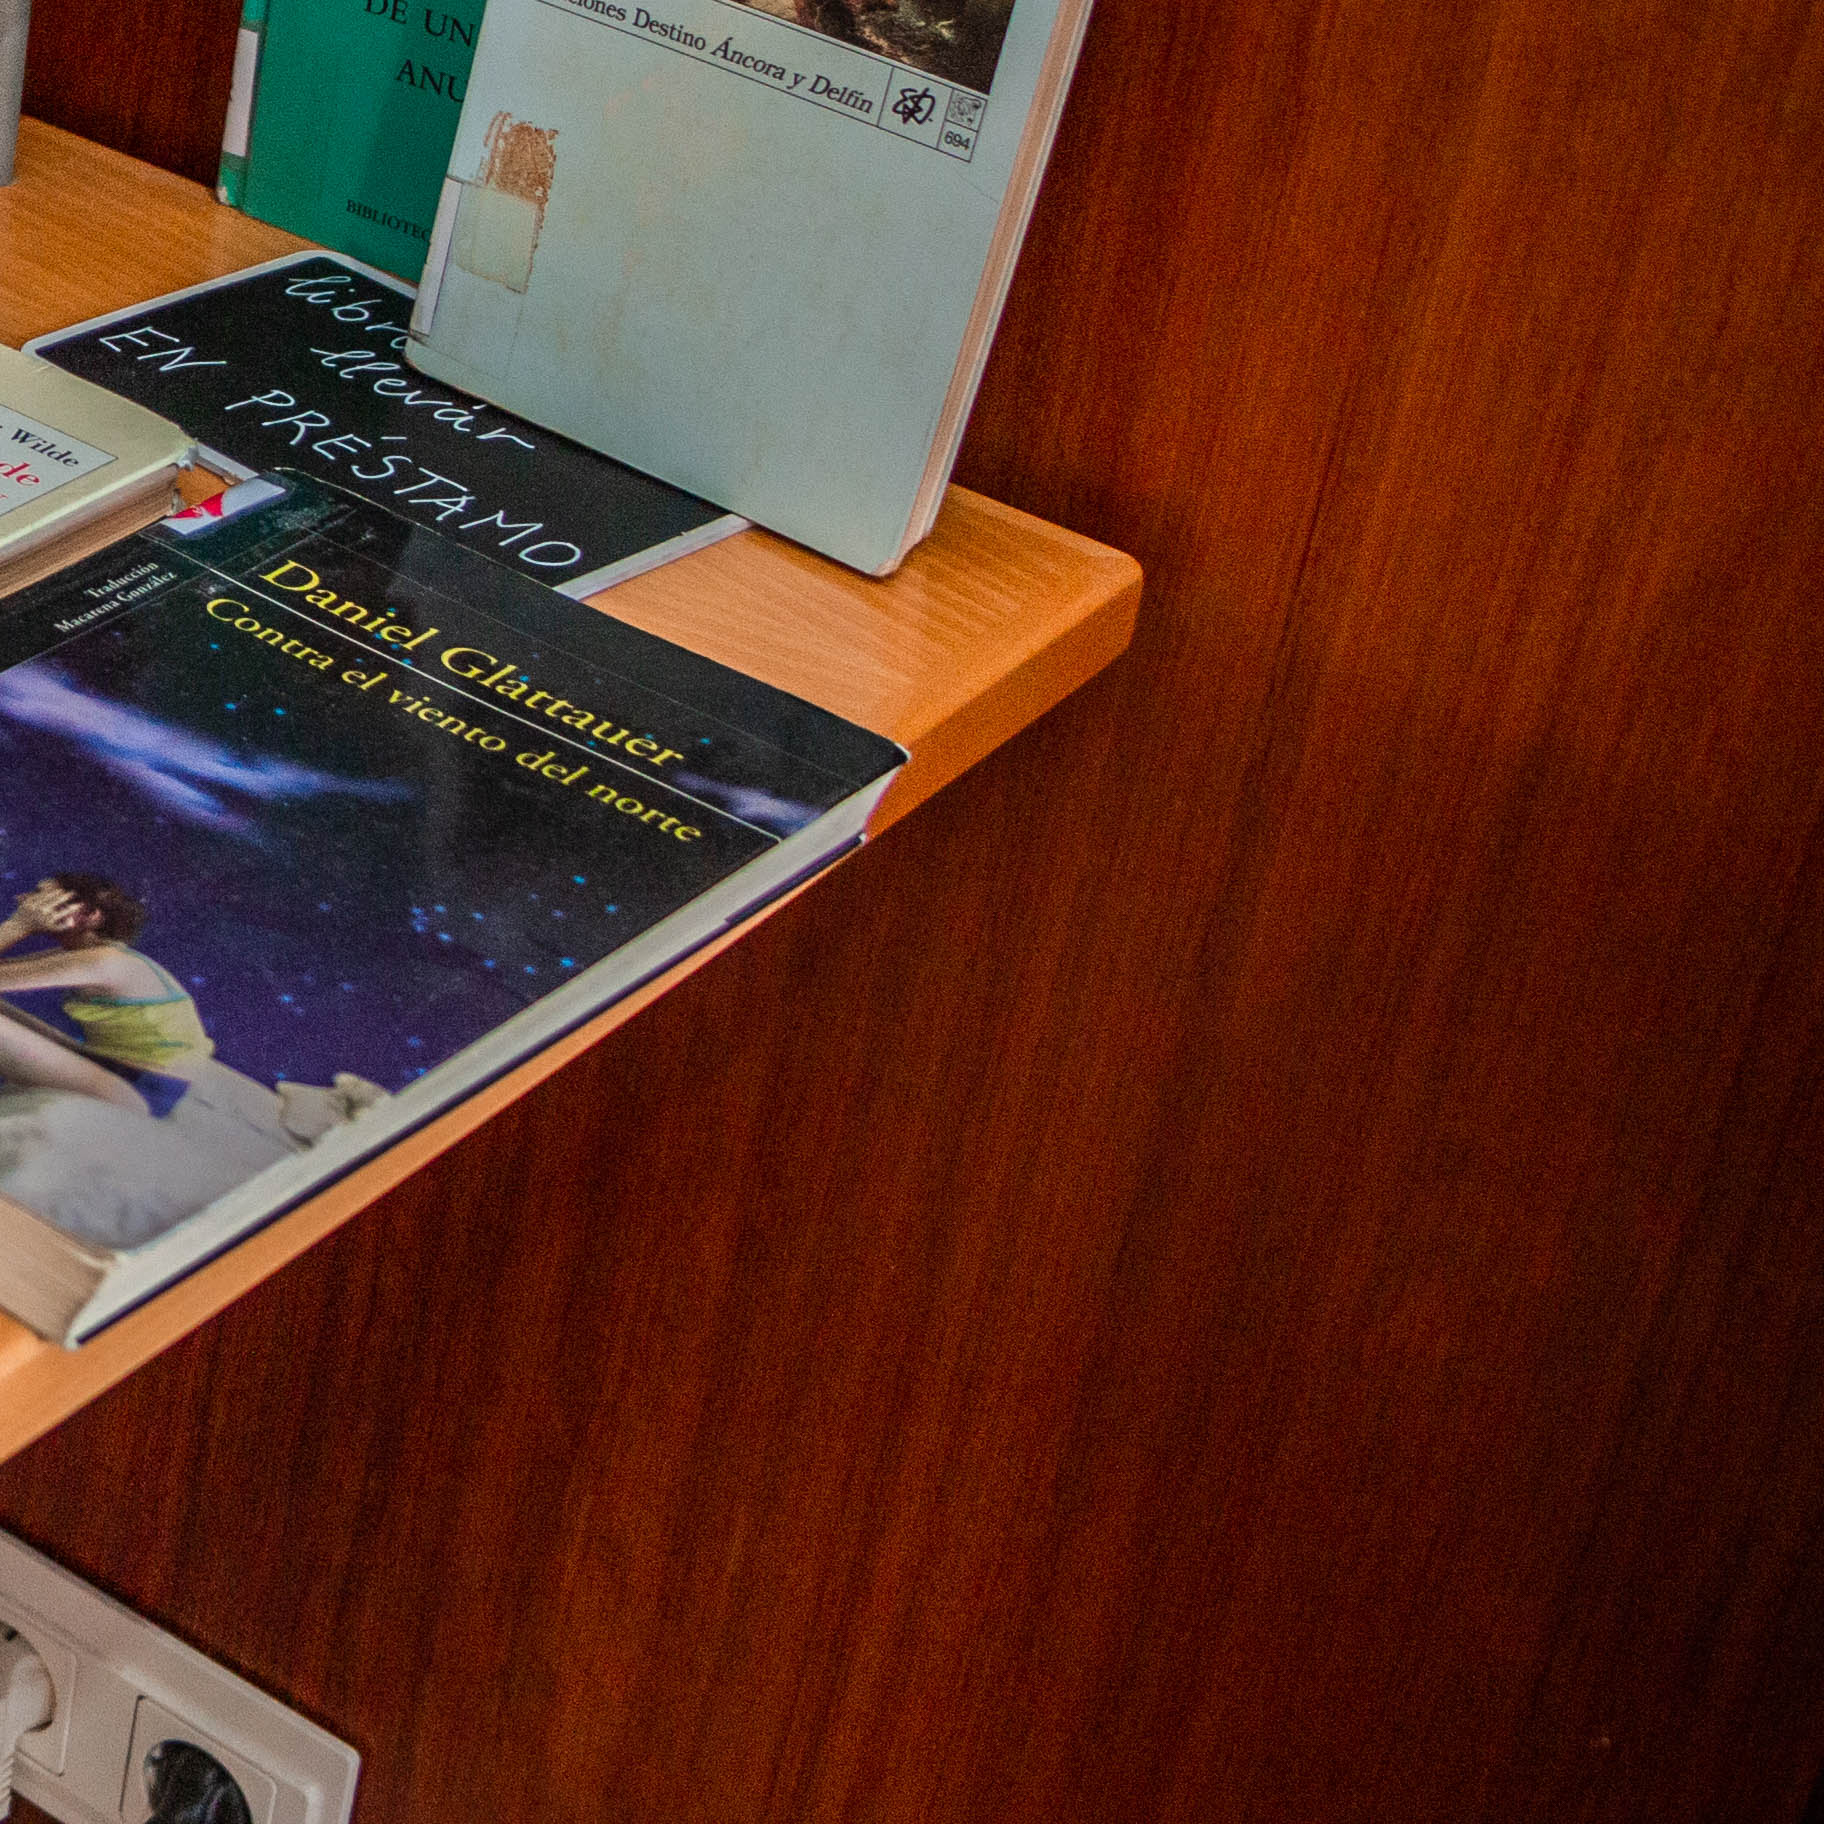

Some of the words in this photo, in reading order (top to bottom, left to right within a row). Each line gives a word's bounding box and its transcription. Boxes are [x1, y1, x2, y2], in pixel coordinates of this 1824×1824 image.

[632, 7, 707, 53] Destino
[710, 34, 787, 81] Áncora
[787, 69, 809, 91] y
[808, 73, 874, 114] Delfín
[943, 128, 972, 152] 694
[10, 427, 82, 469] Wilde
[99, 324, 227, 373] EN
[223, 387, 583, 569] PRÉSTAMO
[52, 596, 121, 634] Macarena
[82, 560, 160, 602] Traducción
[257, 557, 439, 652] Daniel
[439, 646, 685, 767] Glattauer
[204, 596, 337, 672] Contra
[340, 660, 389, 692] el
[387, 686, 507, 752] viento
[515, 747, 592, 787] del
[584, 783, 703, 844] norte
